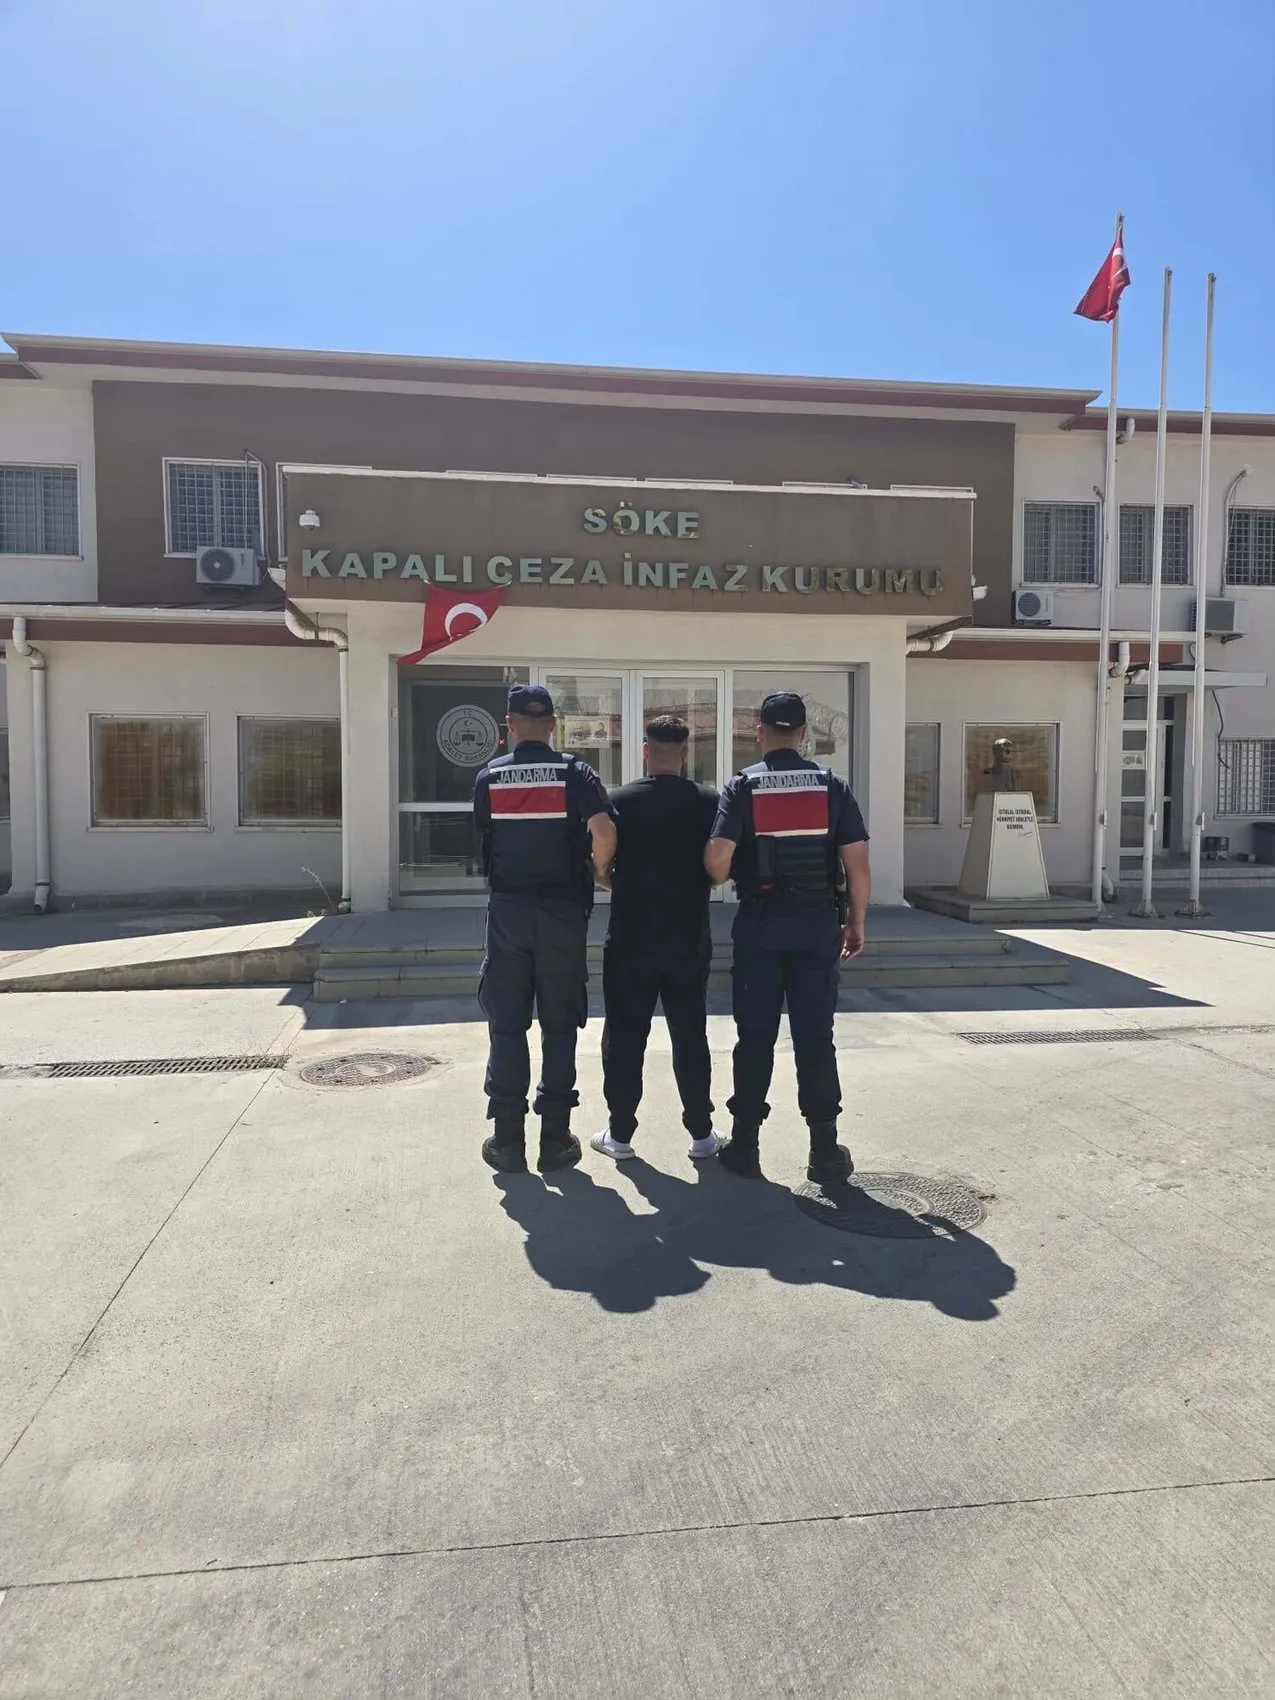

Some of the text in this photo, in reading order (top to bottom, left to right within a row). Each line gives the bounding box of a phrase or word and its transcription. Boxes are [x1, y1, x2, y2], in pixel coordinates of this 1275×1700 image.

[583, 500, 700, 539] SÖKE
[301, 549, 946, 597] KAPALI CEZA İNFAZ KURUMU
[497, 767, 558, 784] JANDARMA
[757, 774, 819, 789] JANDARMA
